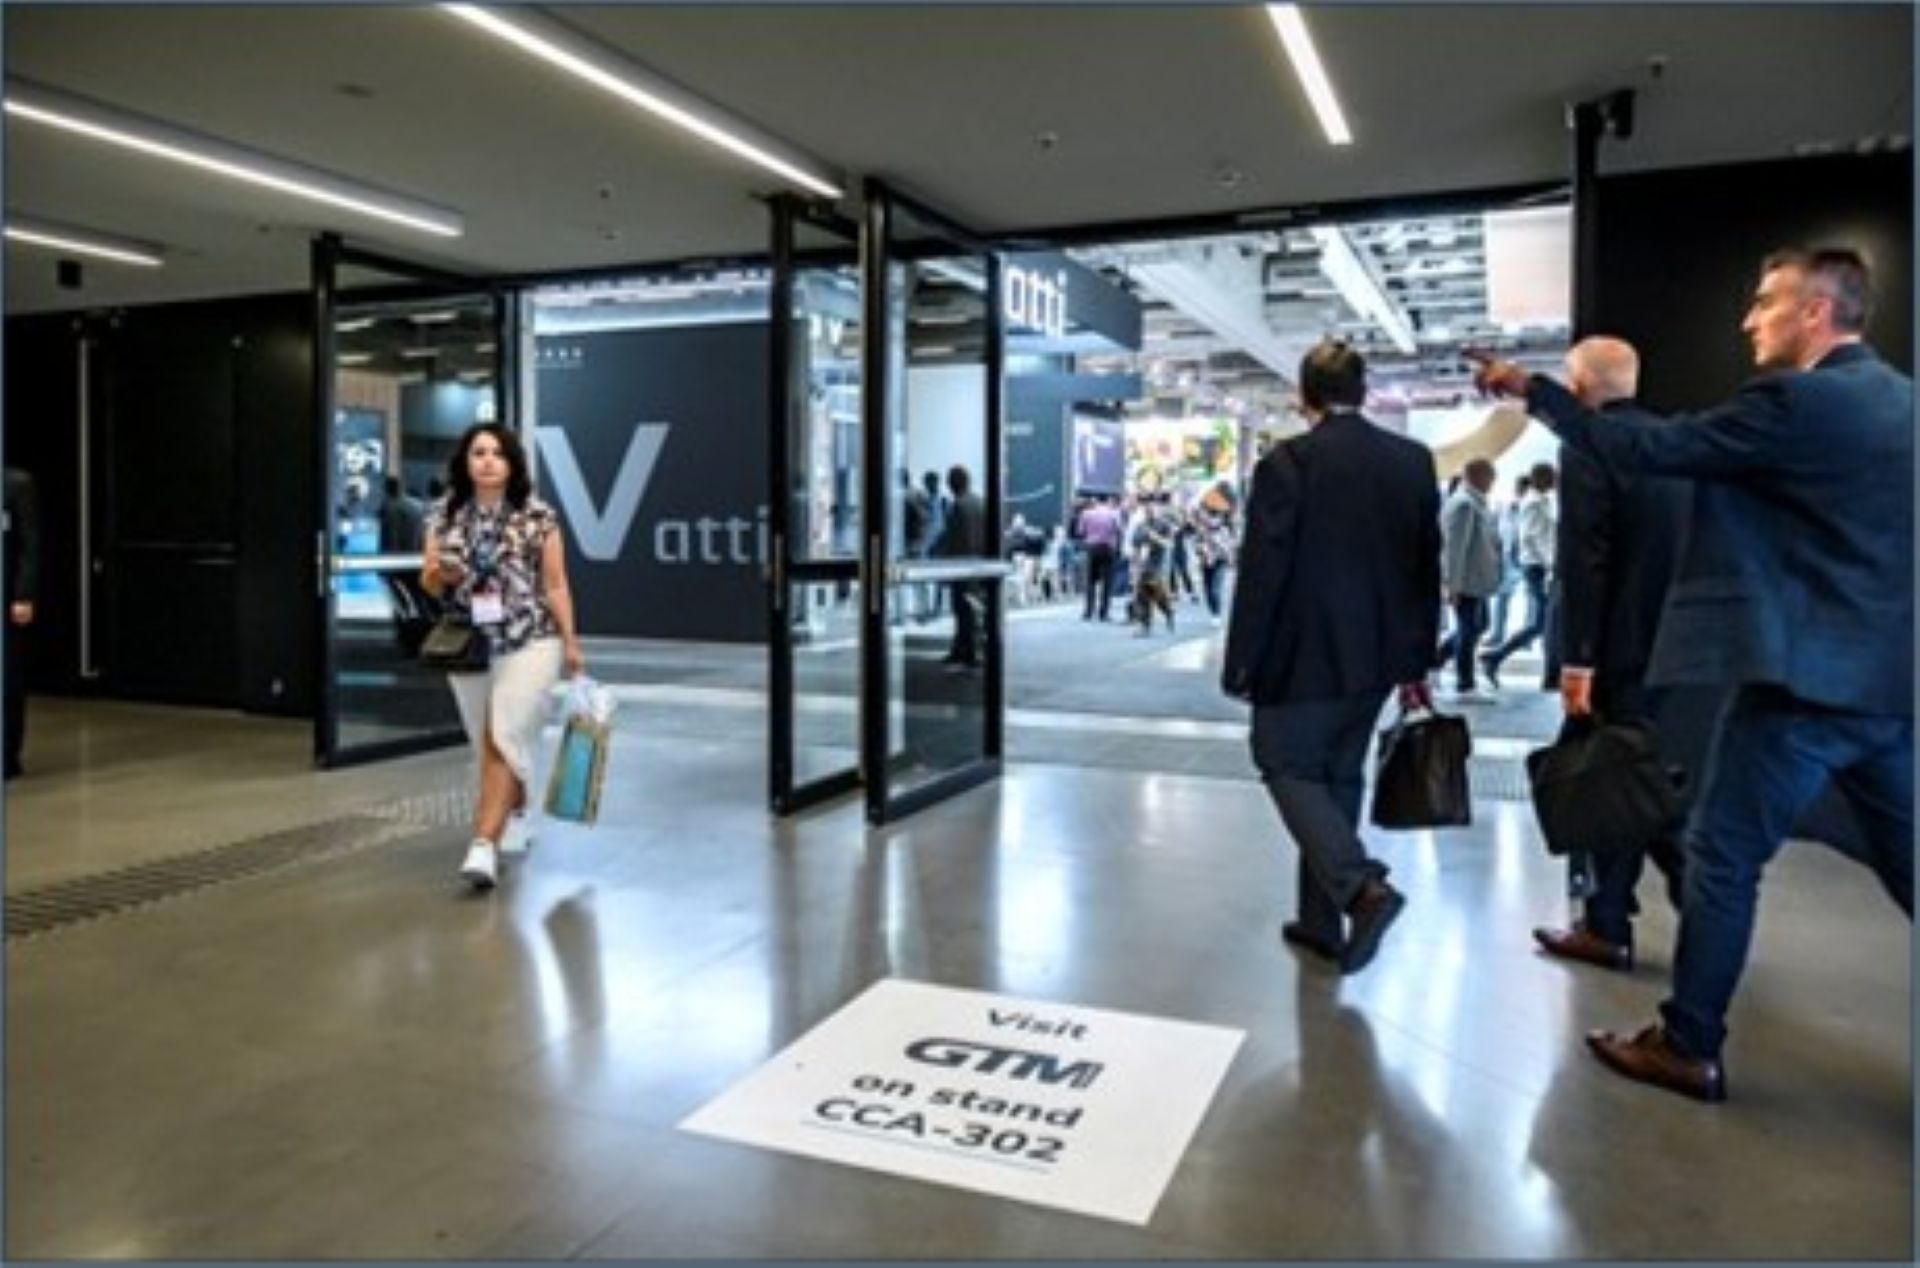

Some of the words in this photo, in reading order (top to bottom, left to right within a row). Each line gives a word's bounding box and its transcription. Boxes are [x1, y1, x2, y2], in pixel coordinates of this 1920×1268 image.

[988, 1008, 1089, 1041] Visit
[903, 1037, 1105, 1090] GTM
[852, 1075, 916, 1098] on
[928, 1087, 1085, 1129] stand
[814, 1096, 1067, 1163] CCA-302
